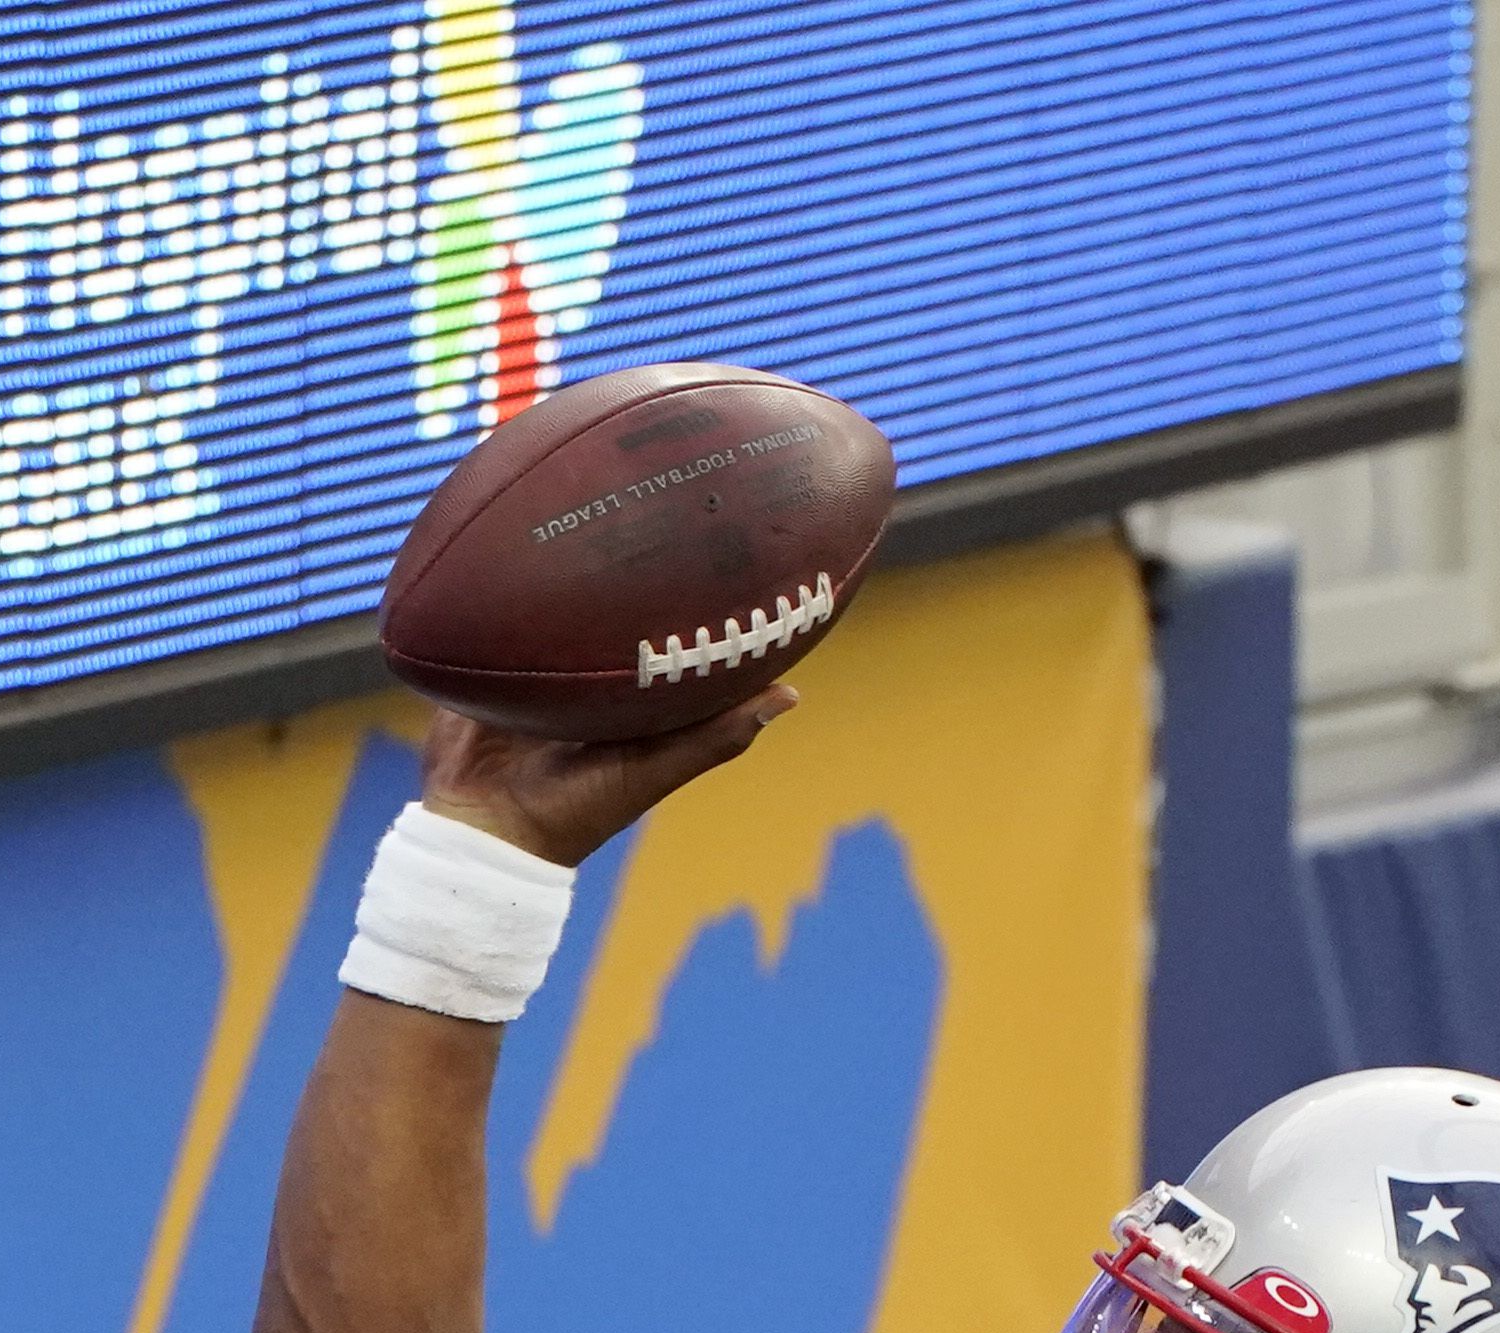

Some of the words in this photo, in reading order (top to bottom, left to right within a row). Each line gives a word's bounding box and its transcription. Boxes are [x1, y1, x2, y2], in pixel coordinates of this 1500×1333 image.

[1, 27, 420, 407] Hospital
[741, 422, 824, 459] NATIONAL
[626, 446, 737, 499] FOOTBALL
[531, 493, 621, 544] LEAGUE
